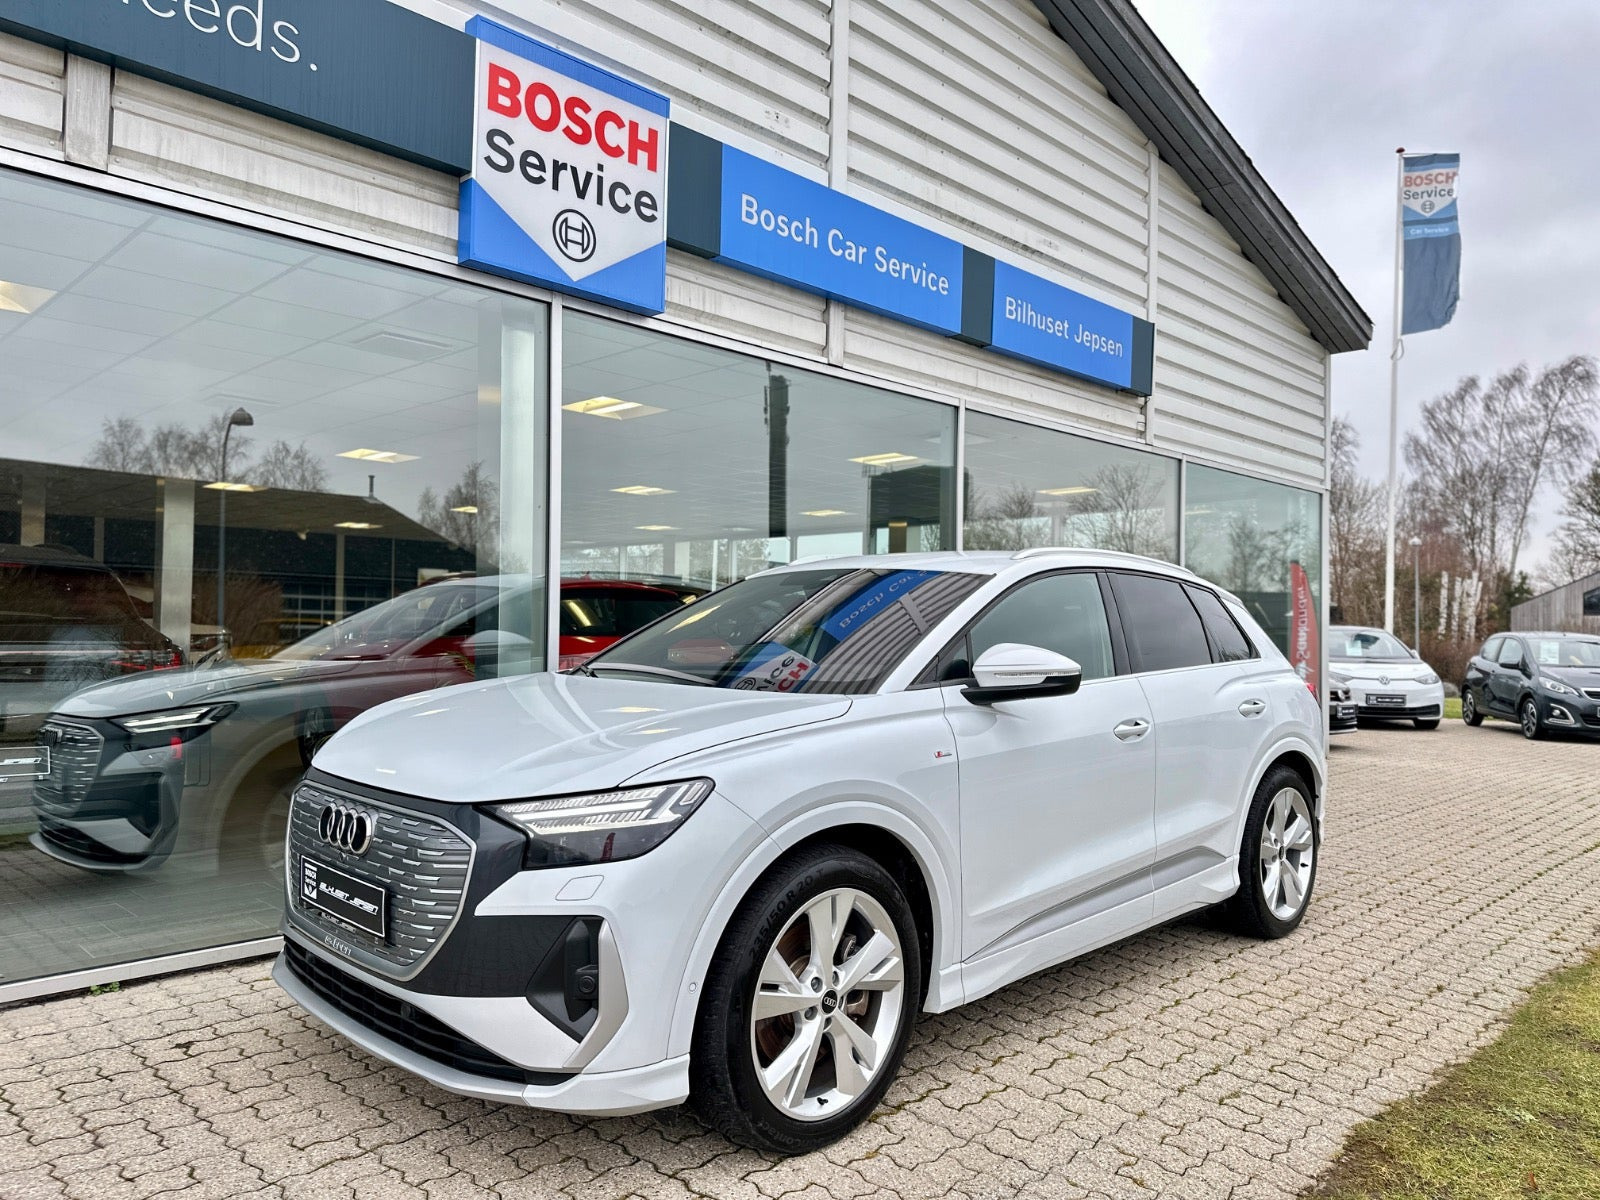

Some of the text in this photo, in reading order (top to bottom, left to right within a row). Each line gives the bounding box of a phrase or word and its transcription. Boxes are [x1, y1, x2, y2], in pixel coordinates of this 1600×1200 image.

[488, 62, 658, 173] BOSCH
[484, 128, 658, 223] Service
[1403, 171, 1458, 187] BOSCH
[1403, 186, 1453, 200] Service
[741, 192, 949, 295] Bosch Car Service
[1005, 296, 1123, 357] Bilhuset Jepsen
